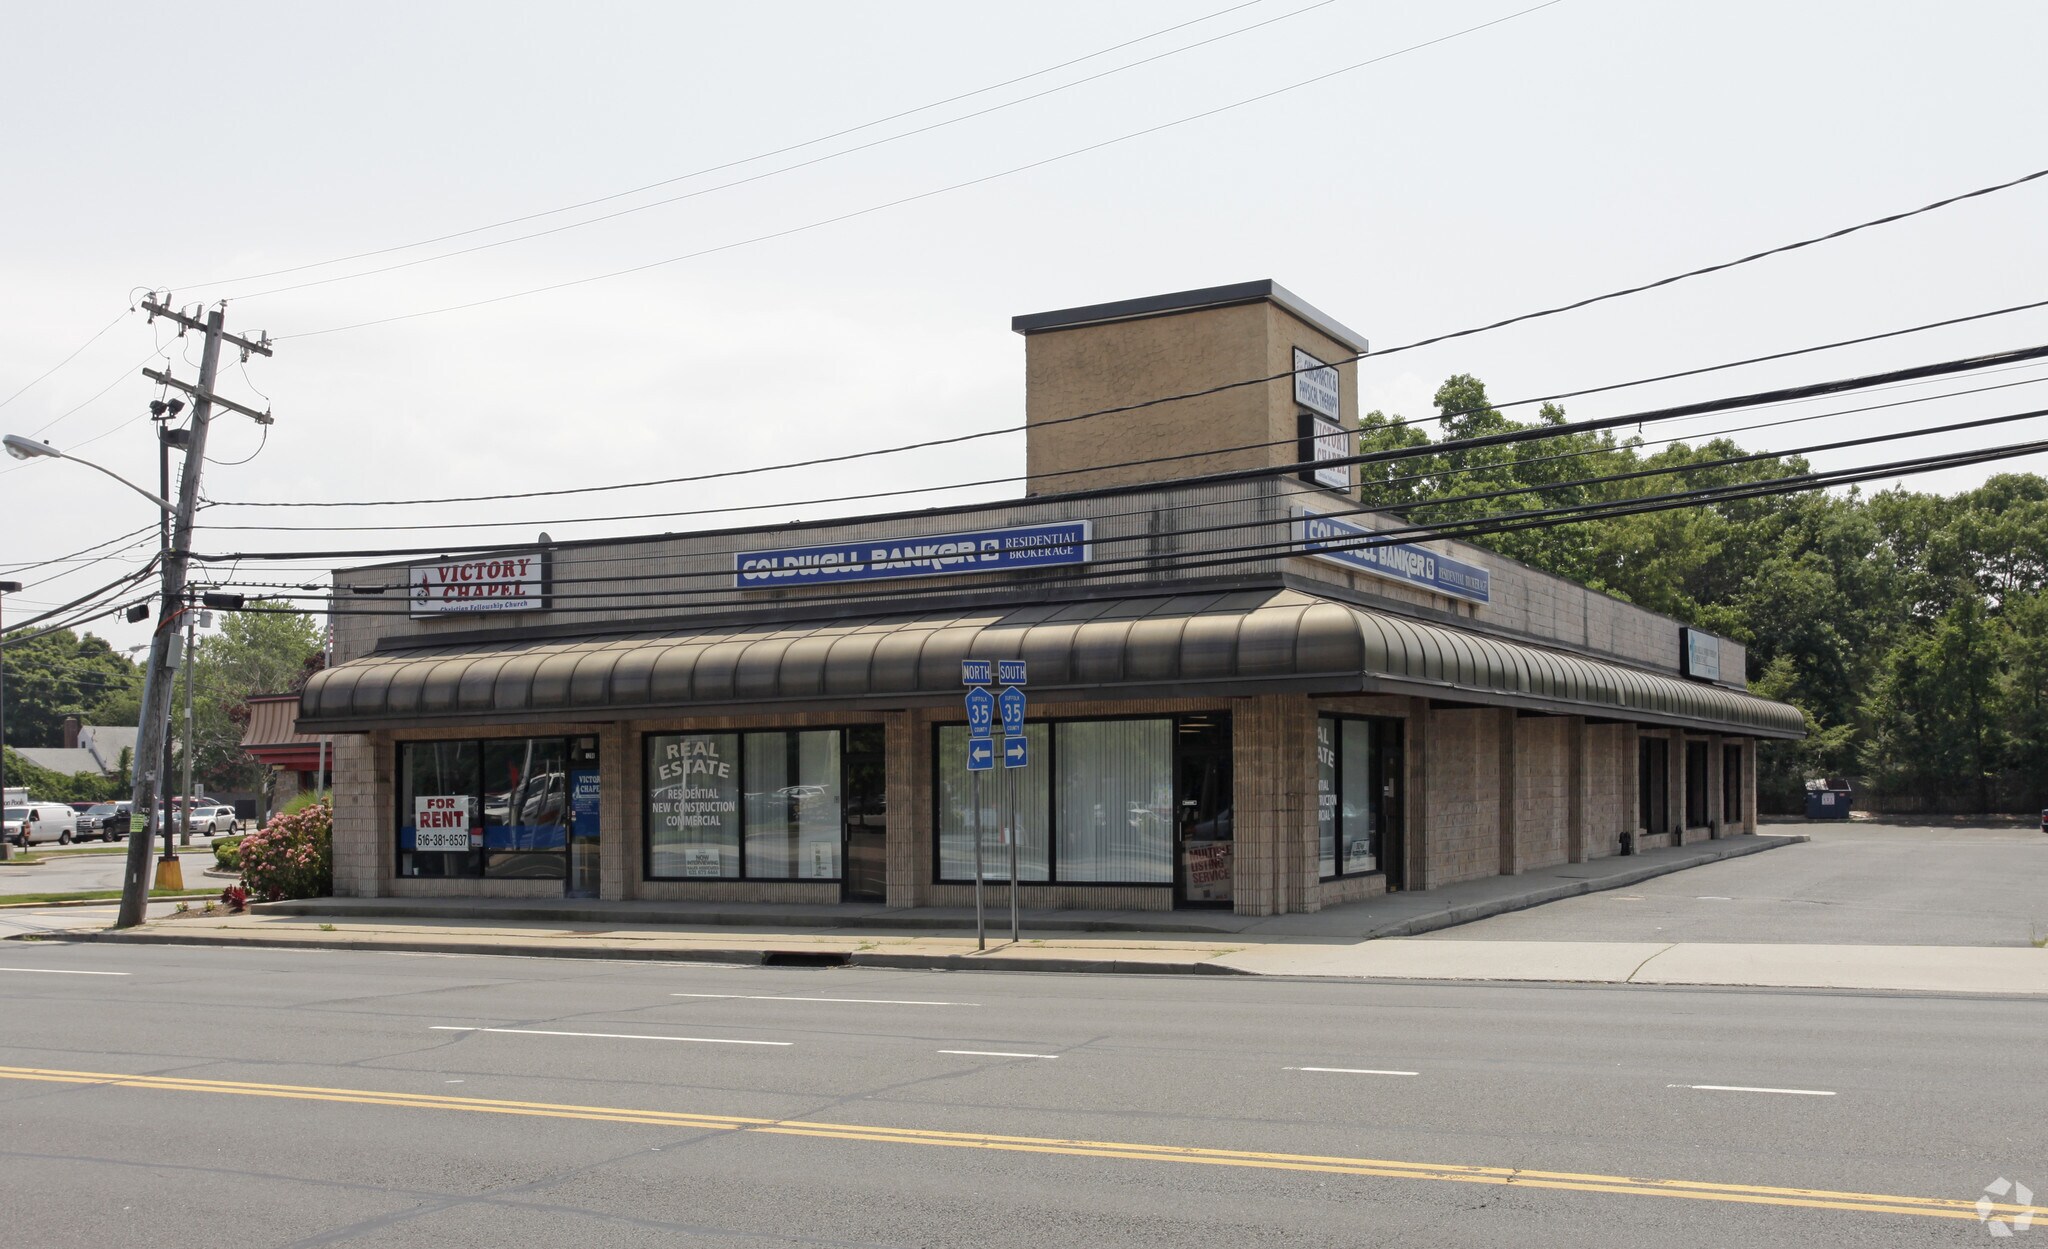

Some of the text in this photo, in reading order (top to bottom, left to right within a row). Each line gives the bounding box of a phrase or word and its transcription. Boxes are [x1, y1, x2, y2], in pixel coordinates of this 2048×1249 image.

[1299, 379, 1337, 414] PHYSICAL THERAPY
[1314, 419, 1347, 452] VICTORY
[1005, 532, 1078, 549] RESIDENTIAL
[743, 541, 976, 580] COLDWELL BANKER
[1009, 546, 1075, 560] BROKERAGE
[438, 558, 531, 583] VICTORY
[1379, 545, 1425, 578] BANKER
[1438, 566, 1464, 586] RESIDENTIAL
[442, 581, 526, 603] CHAPEL
[470, 602, 503, 612] Fellowship
[504, 600, 528, 608] Church
[963, 665, 990, 680] NORTH
[1000, 665, 1026, 680] SOUTH
[972, 705, 989, 724] 35
[1004, 704, 1021, 722] 35
[666, 741, 719, 760] REAL
[658, 759, 730, 780] ESTATE
[579, 775, 600, 784] VICTOR
[580, 785, 600, 793] CHAPE
[667, 788, 719, 800] RESIDENTIAL
[427, 798, 455, 809] FOR
[652, 801, 735, 813] NEW CONSTRUCTION
[420, 811, 464, 828] RENT
[666, 815, 721, 827] COMMERCIAL
[417, 834, 467, 846] 516-381-8537
[1191, 858, 1225, 872] LISTING
[1192, 869, 1231, 884] SERVICE
